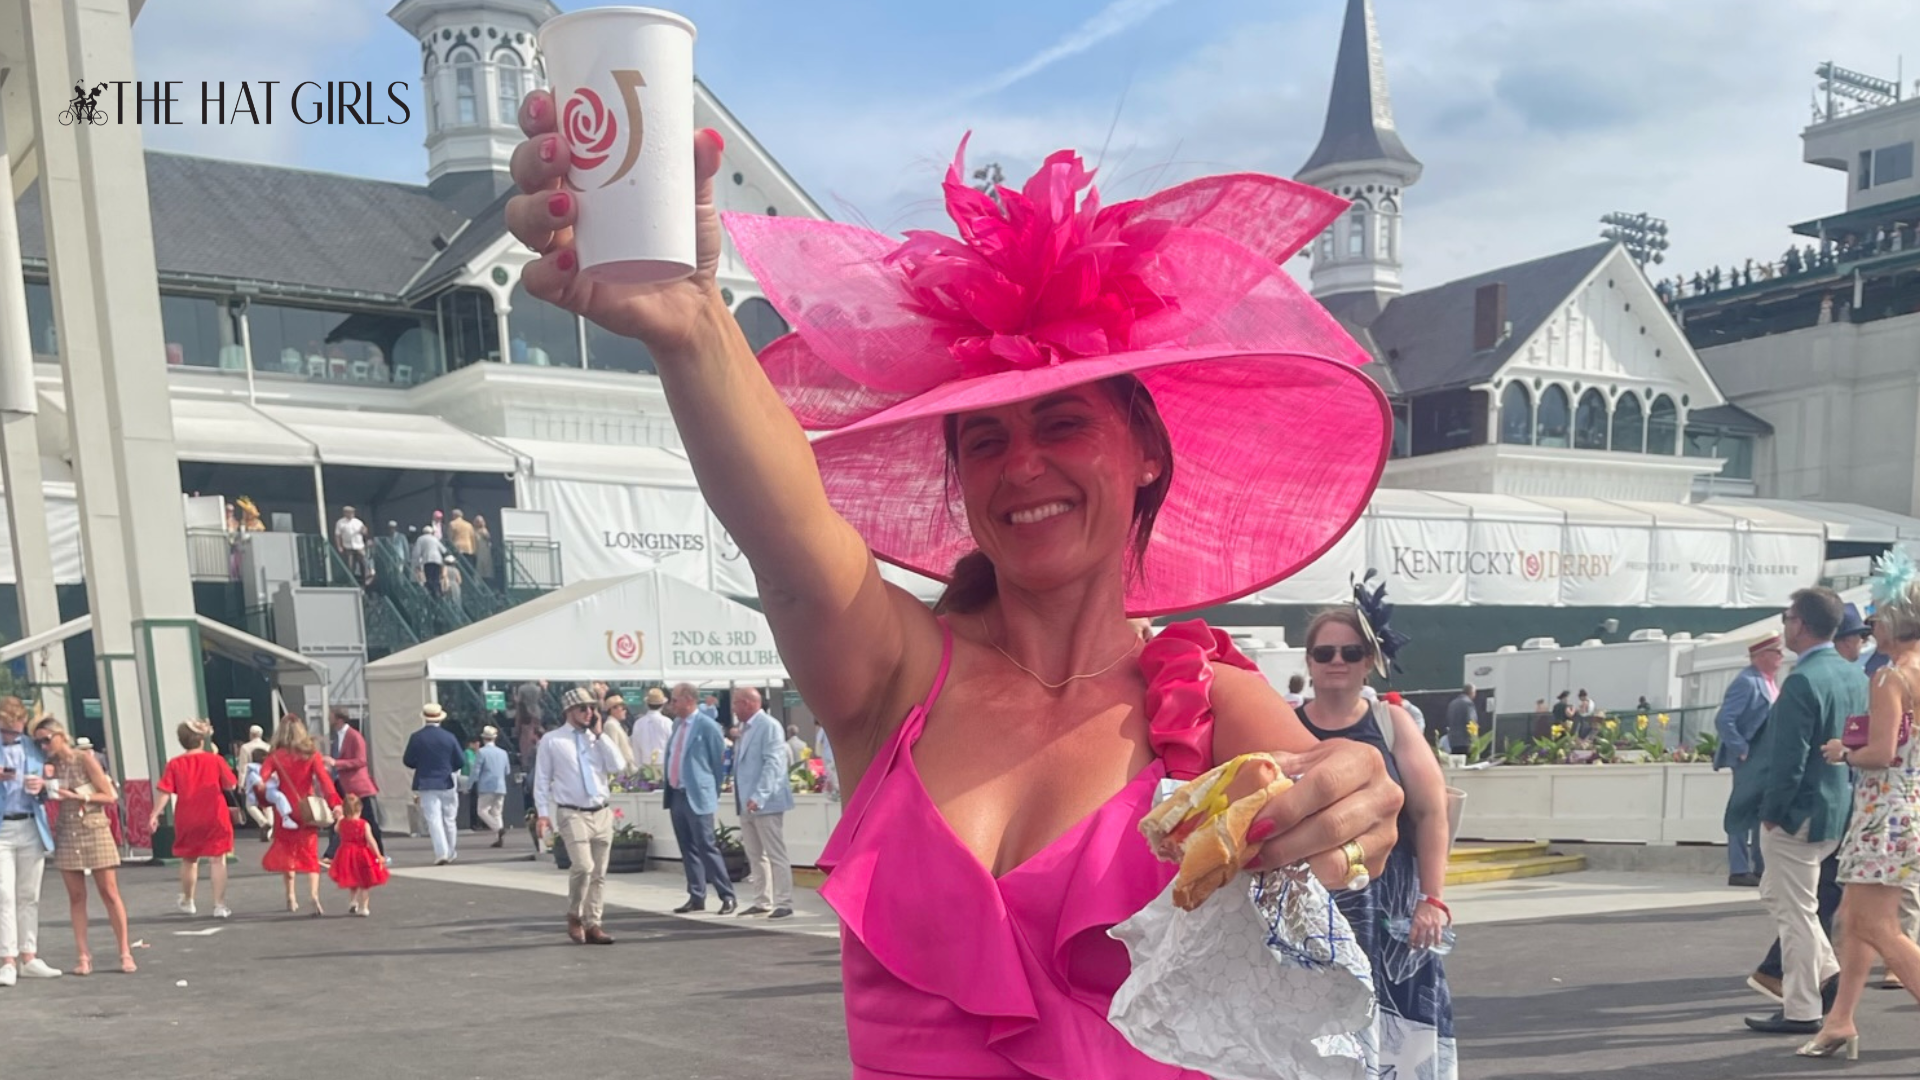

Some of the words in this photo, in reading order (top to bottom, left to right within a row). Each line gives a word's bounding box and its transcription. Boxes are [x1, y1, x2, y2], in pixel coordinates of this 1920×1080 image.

[604, 530, 705, 551] LONGINES
[1391, 546, 1516, 580] KENTUCKY
[1548, 551, 1613, 580] DERBY
[1746, 562, 1799, 575] RESERVE
[671, 630, 705, 646] 2ND
[707, 630, 722, 646] &
[726, 630, 757, 646] 3RD
[672, 650, 726, 666] FLOOR
